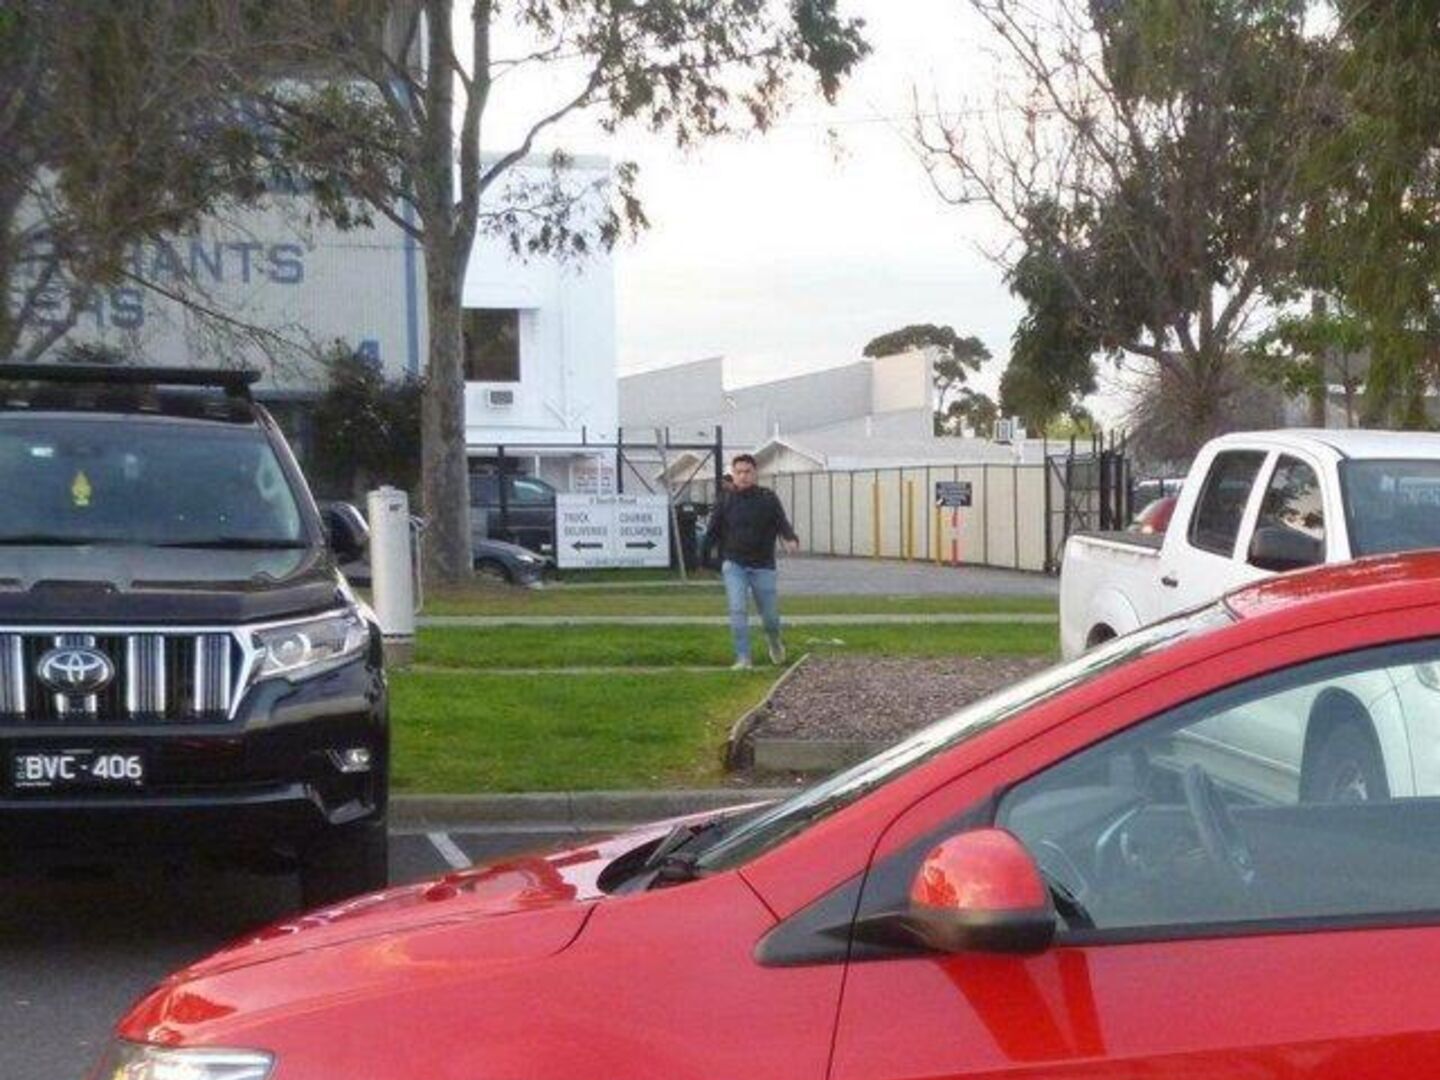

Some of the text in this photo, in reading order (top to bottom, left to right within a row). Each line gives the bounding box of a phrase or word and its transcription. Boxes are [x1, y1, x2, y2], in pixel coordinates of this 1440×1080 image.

[564, 512, 590, 523] TRUCK
[619, 512, 653, 523] COURIER
[564, 526, 608, 537] DELIVERIES
[620, 526, 662, 537] DELIVERIES
[26, 755, 76, 780] BVC
[92, 755, 142, 779] 406
